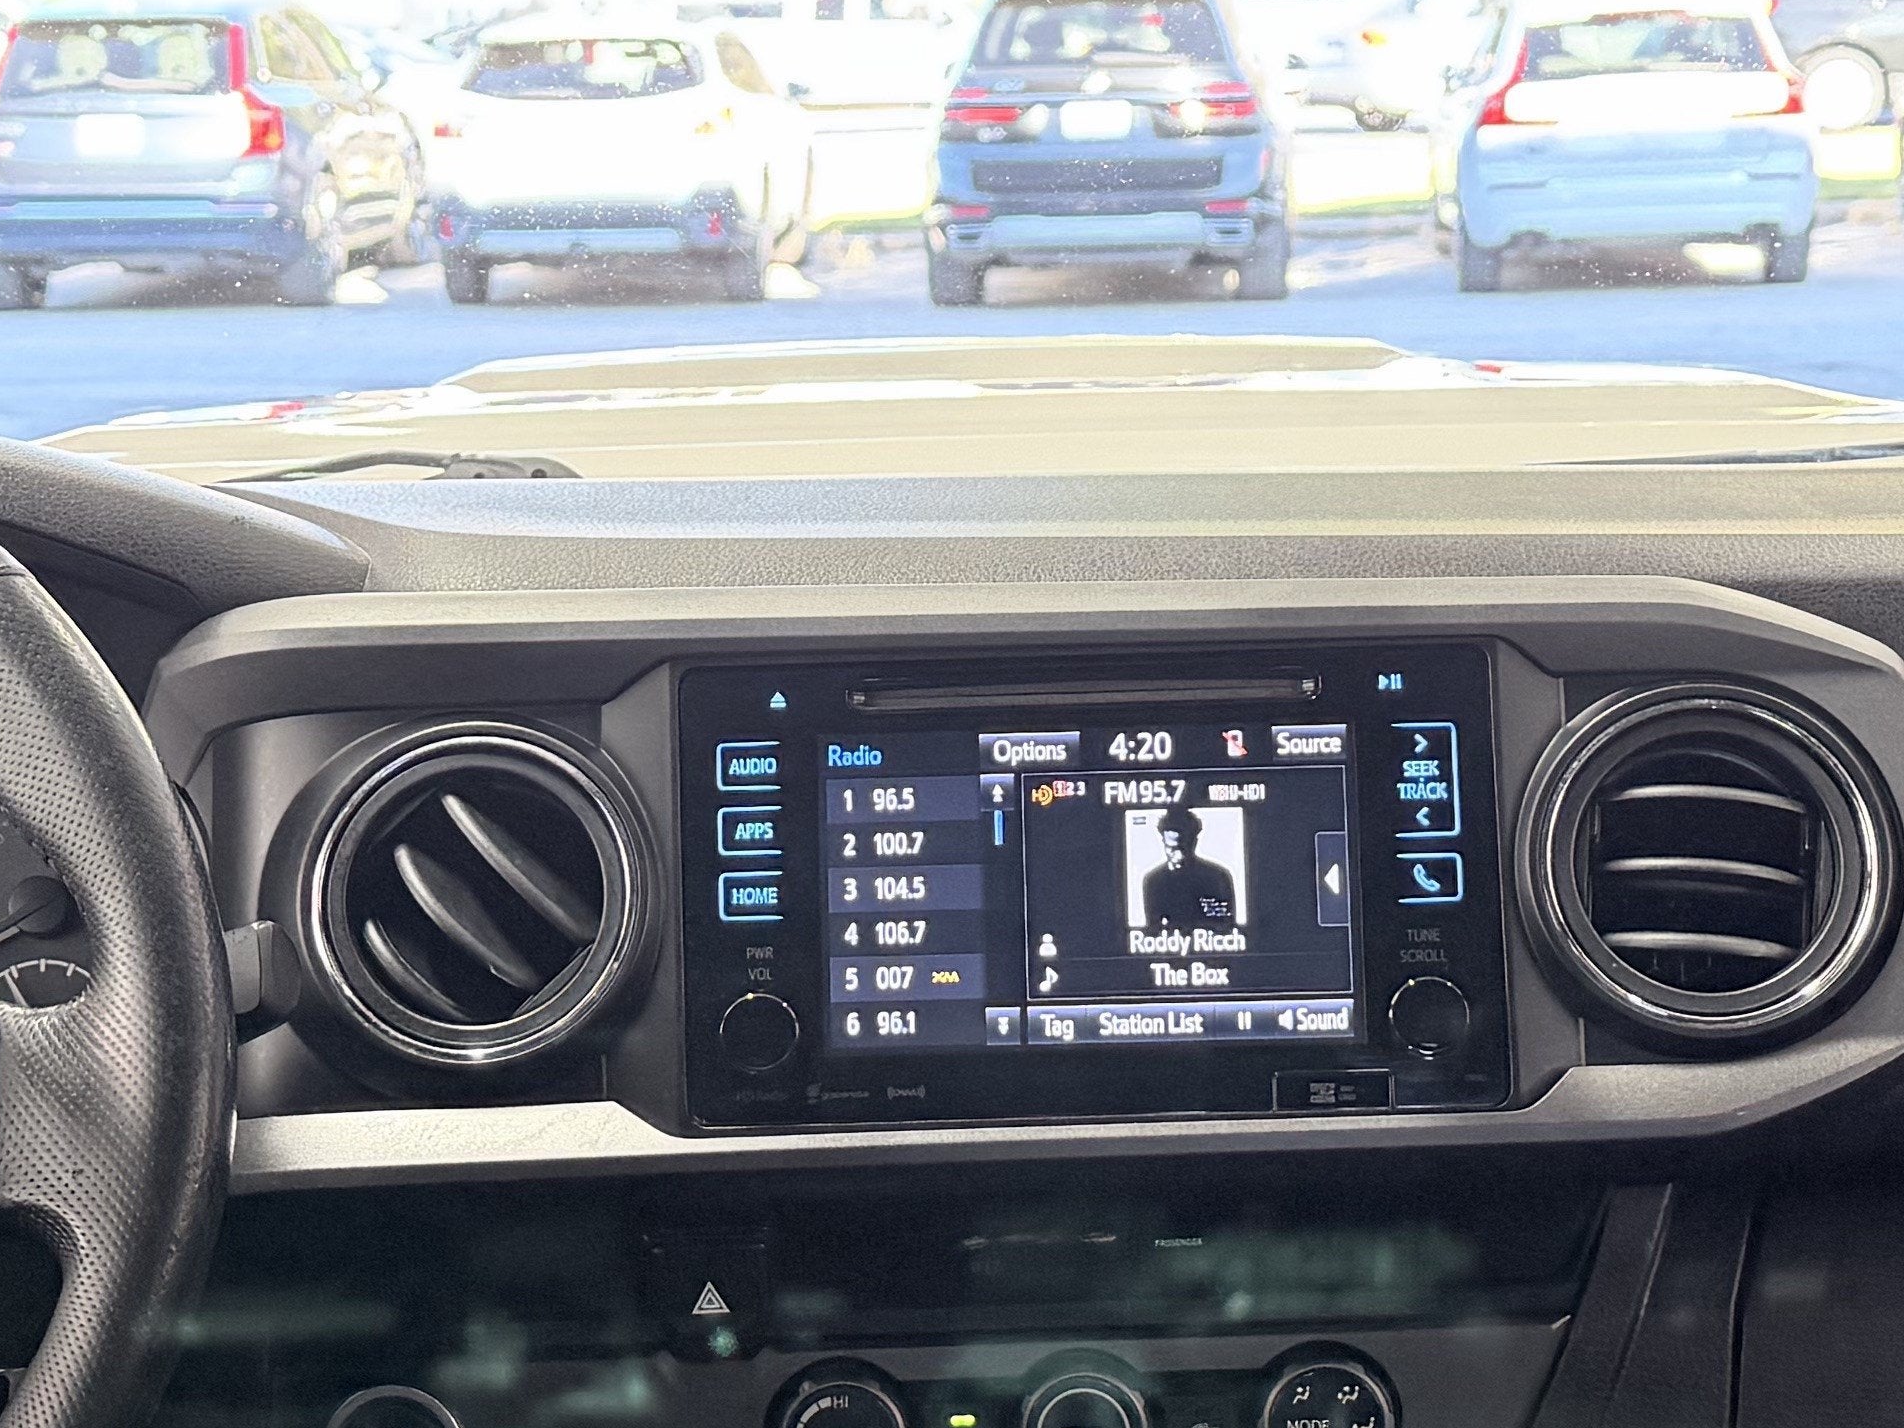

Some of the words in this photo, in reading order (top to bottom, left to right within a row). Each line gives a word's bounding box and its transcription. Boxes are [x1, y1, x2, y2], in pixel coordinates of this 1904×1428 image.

[827, 744, 883, 768] Radio
[992, 740, 1067, 766] Options
[1108, 731, 1173, 762] 4:20
[1276, 732, 1342, 756] Source
[728, 757, 778, 776] AUDIO
[1402, 760, 1440, 778] SEEK
[844, 789, 853, 812] 1
[872, 787, 915, 811] 96.5
[1397, 782, 1449, 800] TRACK
[734, 822, 774, 841] APPS
[843, 833, 857, 857] 2
[873, 832, 925, 855] 100.7
[731, 887, 778, 905] HOME
[844, 878, 858, 902] 3
[874, 876, 926, 900] 104.5
[844, 921, 859, 946] 4
[875, 920, 927, 944] 106.7
[1129, 929, 1191, 956] Roddy
[1193, 927, 1247, 952] Ricch
[1406, 928, 1441, 943] TUNE
[746, 946, 774, 959] PWR
[1400, 948, 1449, 963] SCROLL
[748, 967, 773, 981] VOL
[845, 967, 859, 991] 5
[875, 966, 915, 990] 007
[1150, 963, 1188, 986] The
[1191, 961, 1230, 986] Box
[846, 1012, 860, 1036] 6
[876, 1010, 916, 1034] 96.1
[1040, 1013, 1075, 1041] Tag
[1099, 1011, 1166, 1036] Station
[1167, 1011, 1204, 1034] List
[1295, 1007, 1349, 1031] Sound
[832, 1395, 849, 1409] HI
